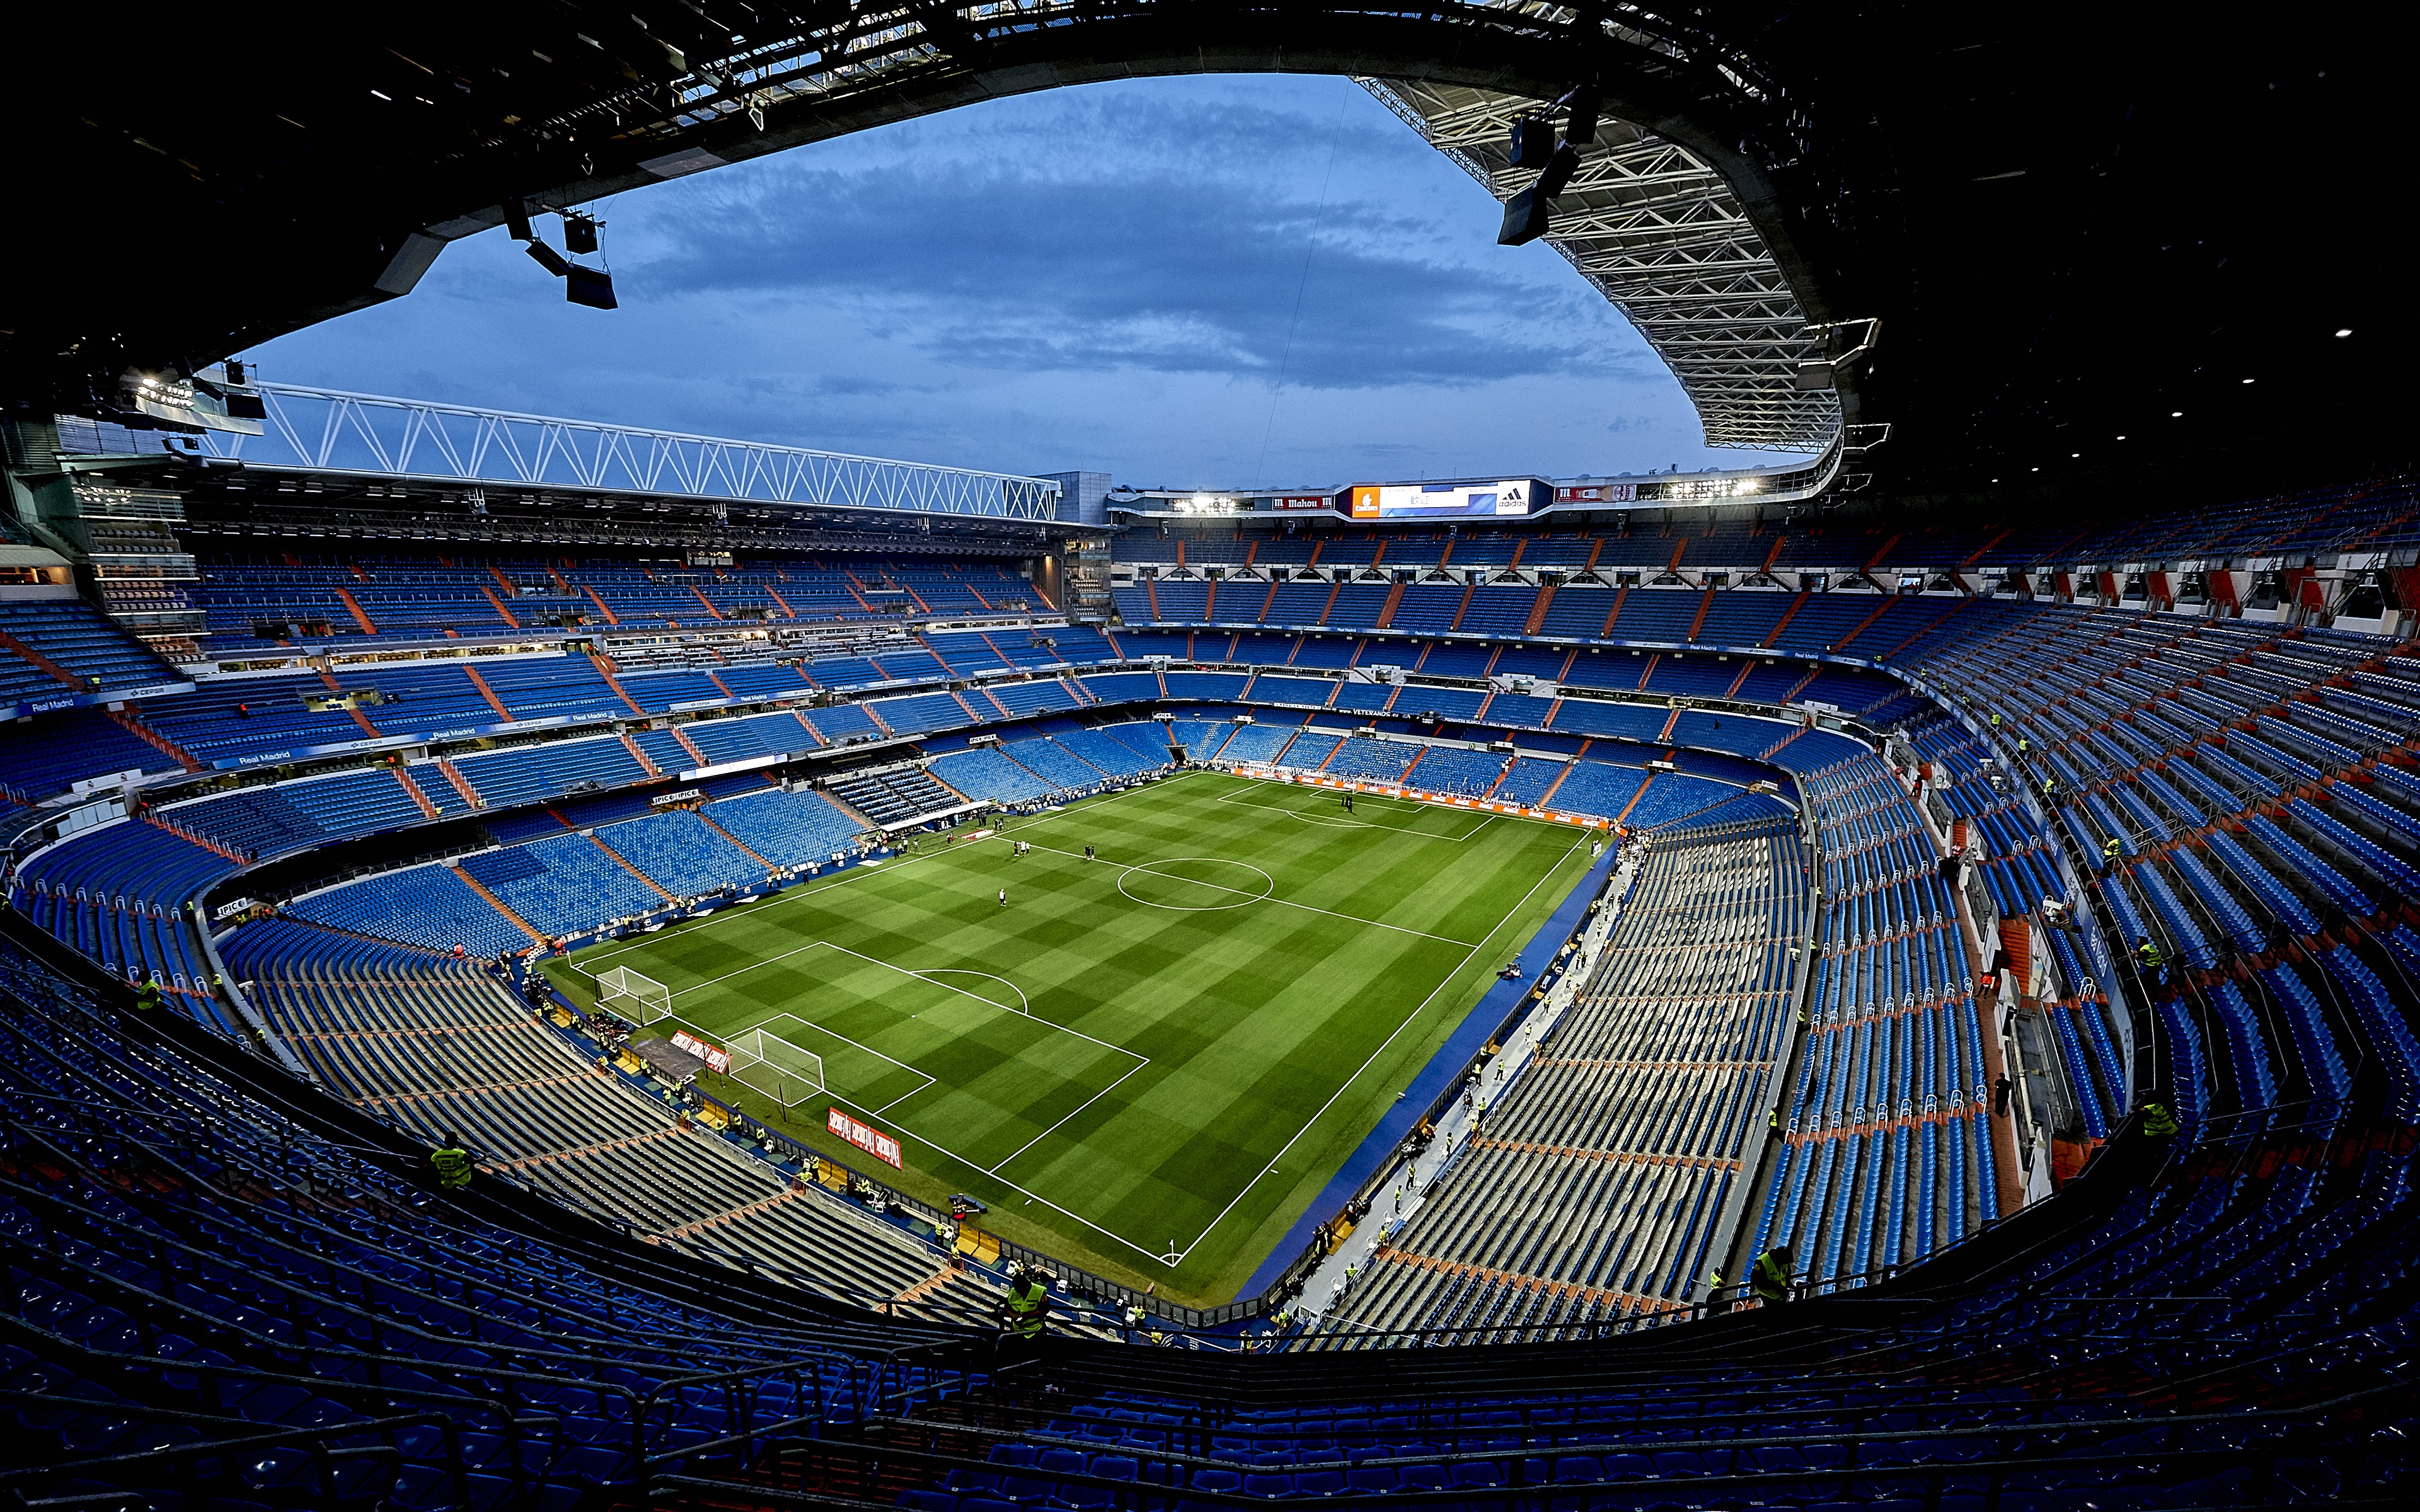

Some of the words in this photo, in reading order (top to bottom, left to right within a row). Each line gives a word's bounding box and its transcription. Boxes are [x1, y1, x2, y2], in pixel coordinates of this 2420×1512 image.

[1288, 499, 1317, 507] Mahou
[33, 704, 48, 712] Real
[50, 699, 74, 709] Madrid
[260, 752, 291, 761] Madrid
[219, 903, 238, 915] IPIC
